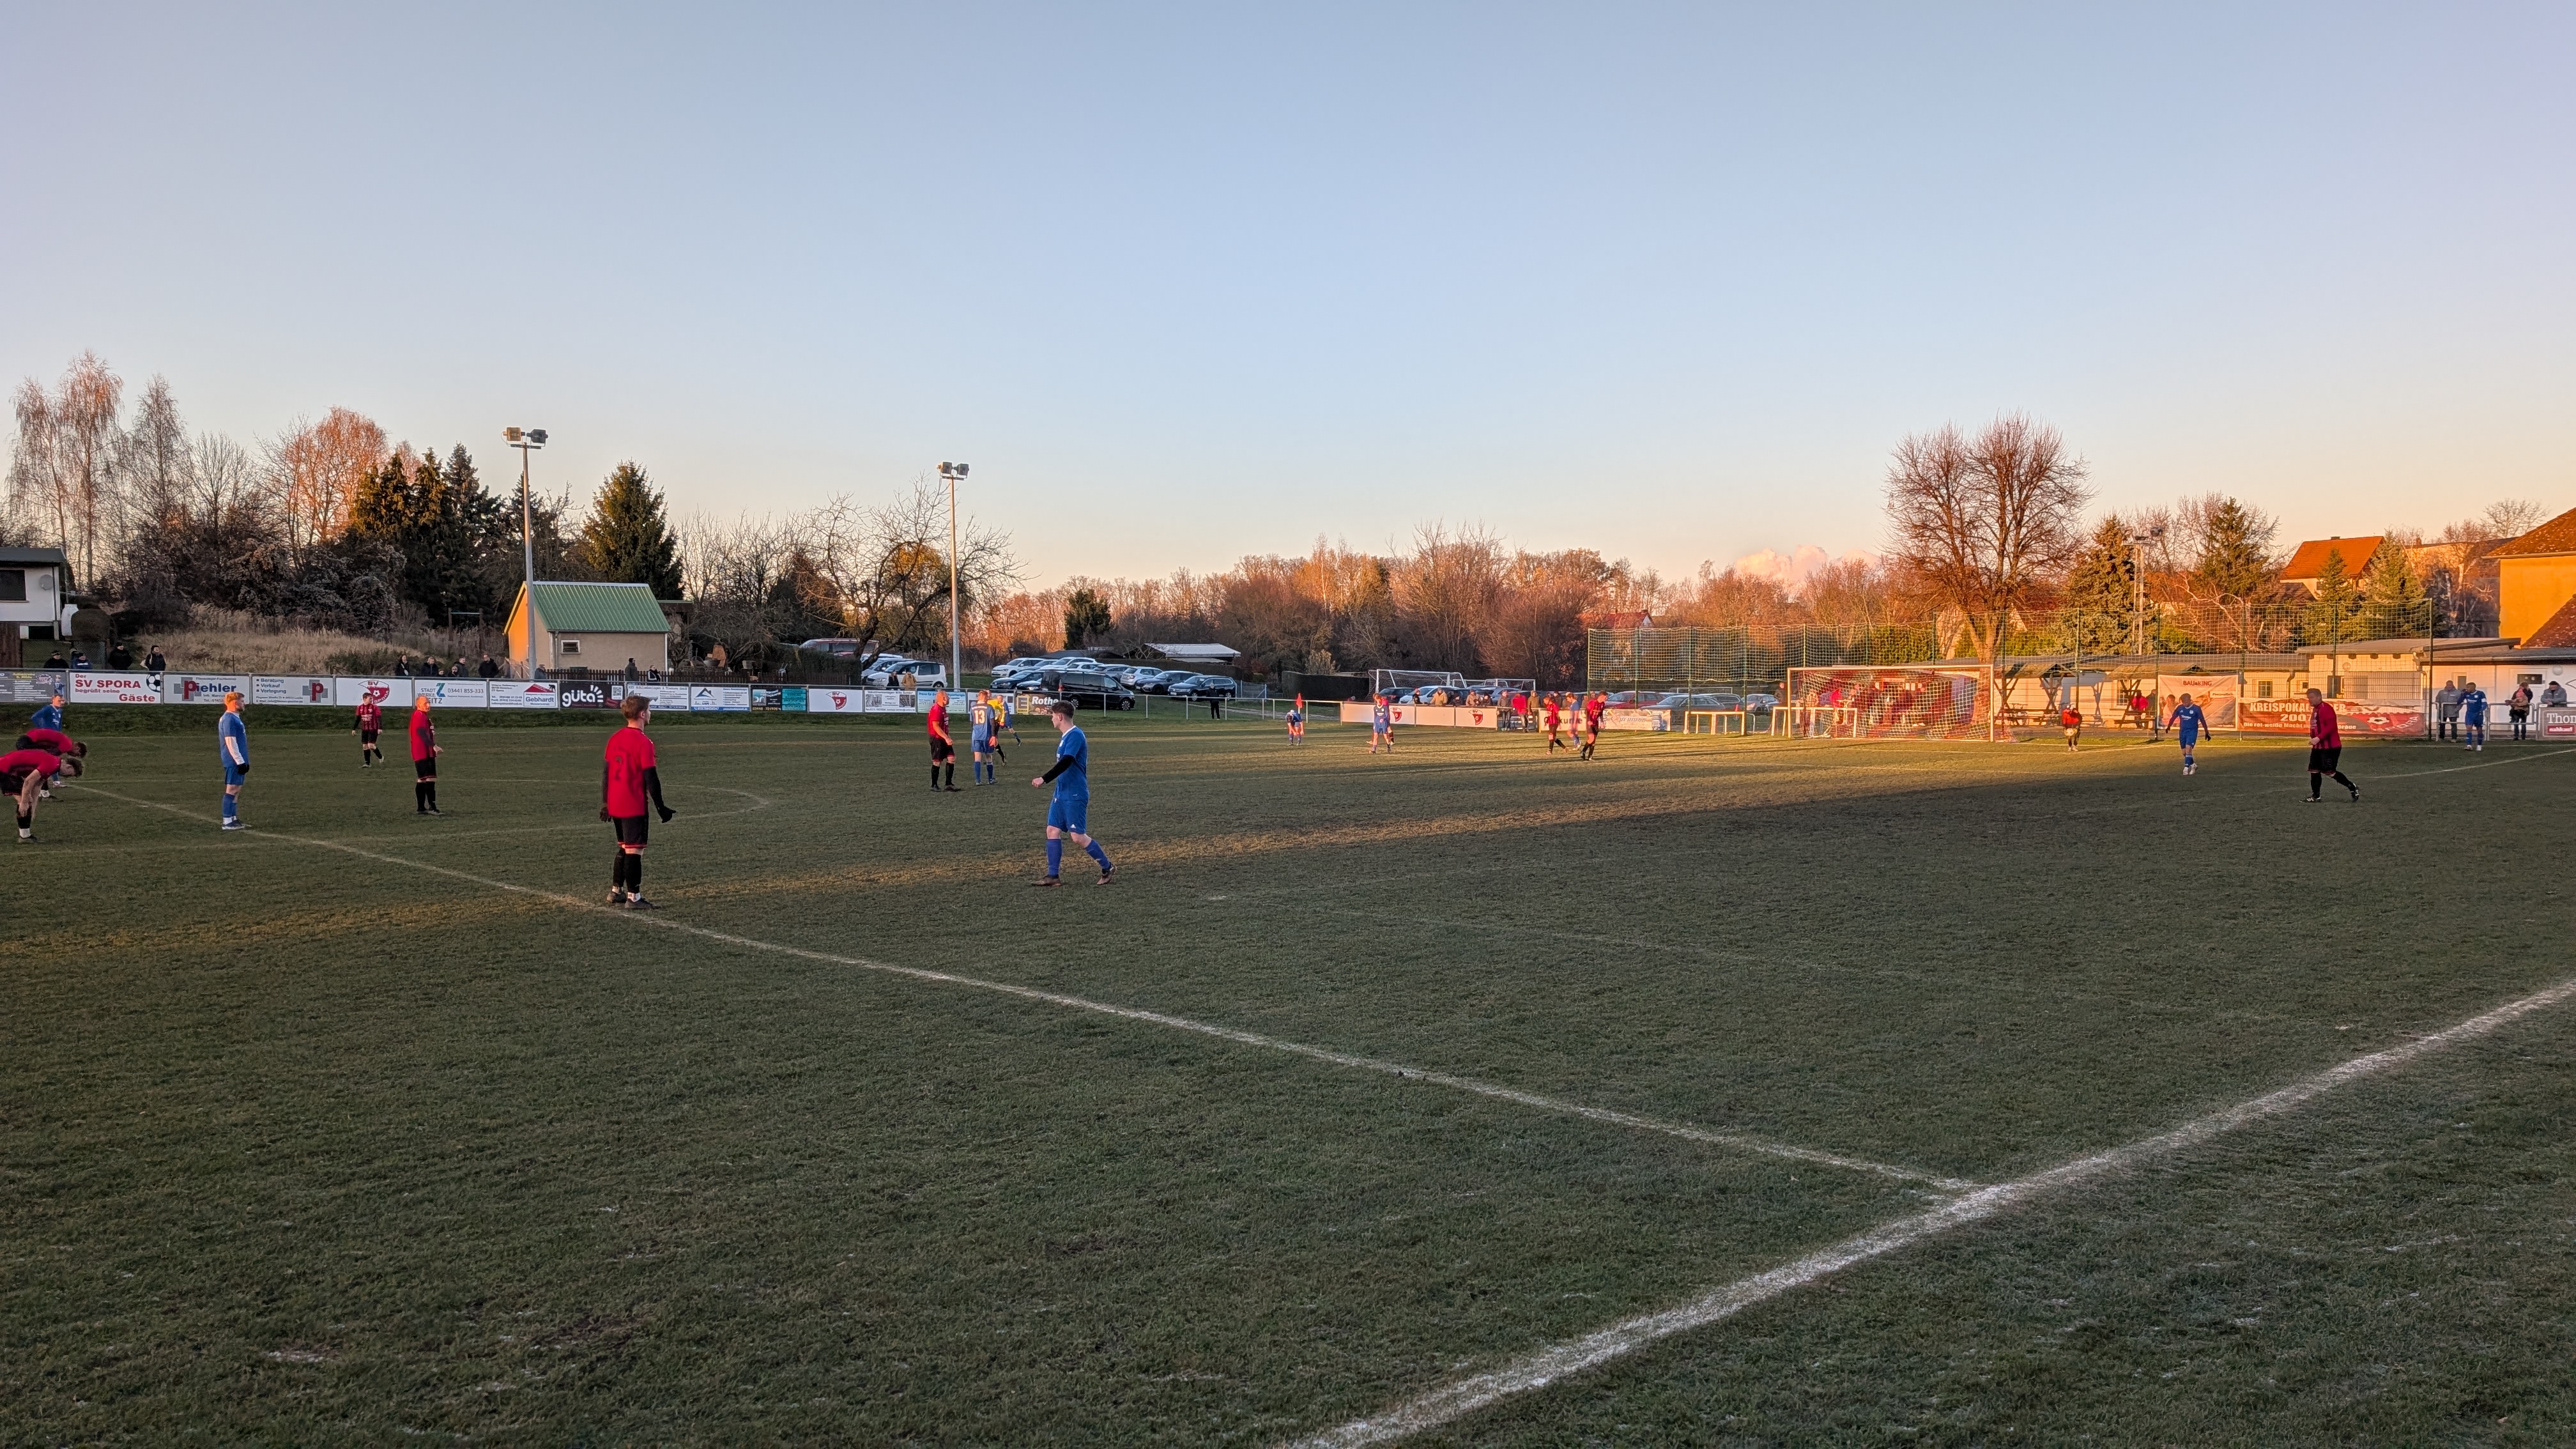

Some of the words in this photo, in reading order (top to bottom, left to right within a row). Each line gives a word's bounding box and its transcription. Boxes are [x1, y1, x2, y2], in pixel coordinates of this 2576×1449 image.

[75, 679, 93, 687] SV
[96, 680, 141, 688] SPORA
[119, 693, 155, 702] Gäste
[1031, 696, 1059, 705] Rothe
[974, 710, 985, 724] 13
[2280, 714, 2312, 722] 2007
